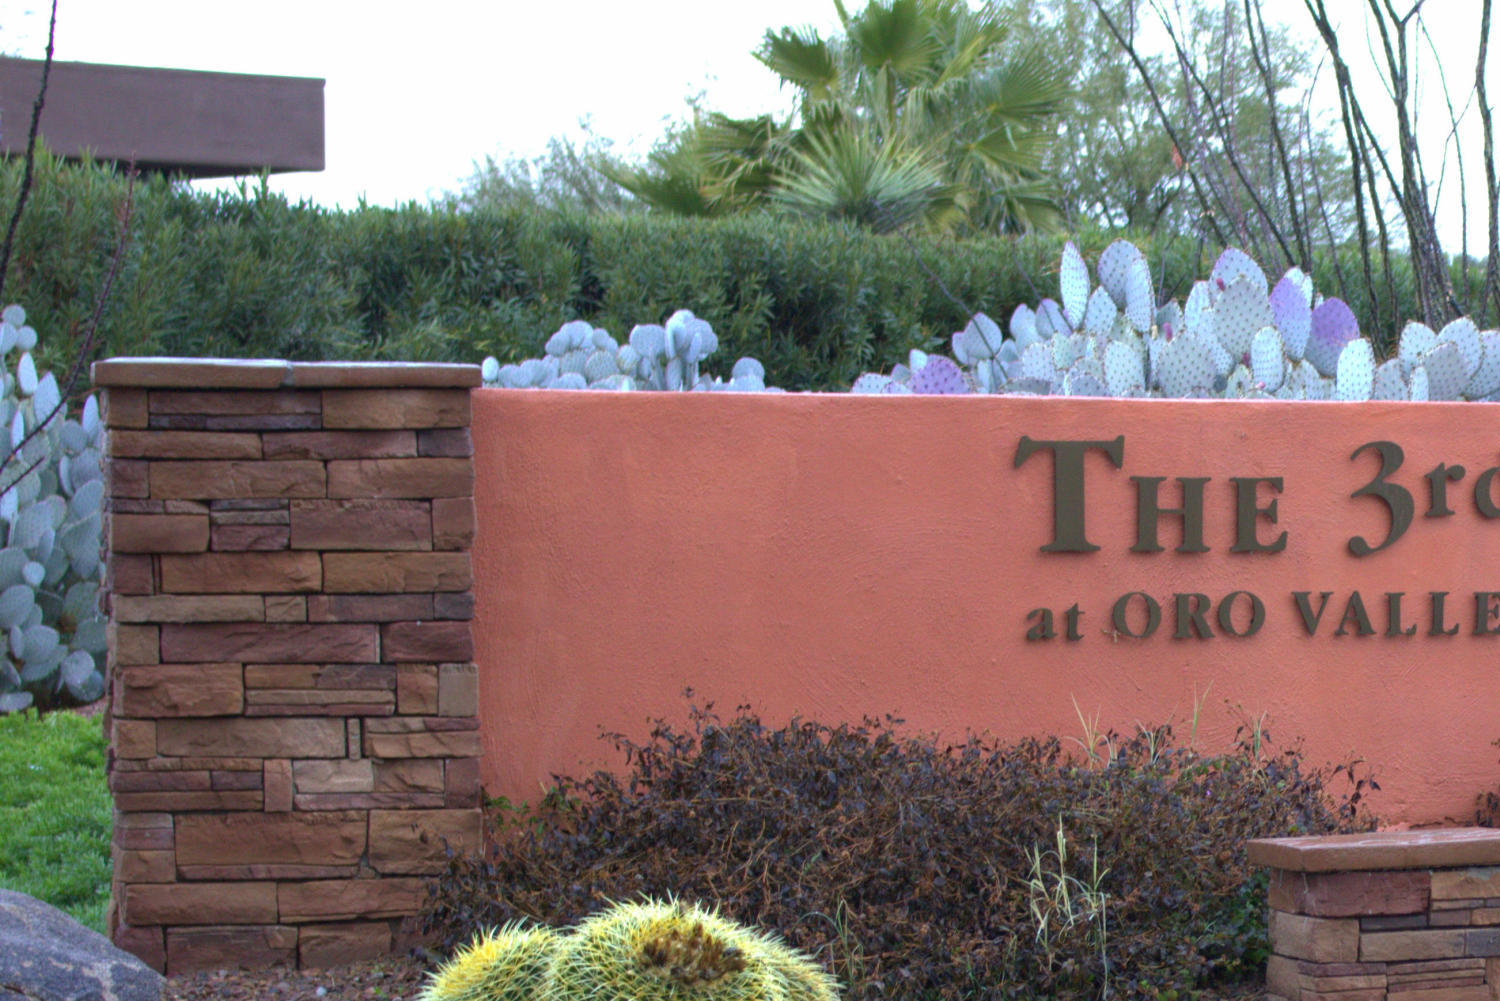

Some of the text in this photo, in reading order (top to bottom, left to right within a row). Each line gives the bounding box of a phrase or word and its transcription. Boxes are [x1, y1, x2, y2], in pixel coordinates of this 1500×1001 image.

[1012, 435, 1289, 559] THE
[1024, 592, 1085, 646] at
[1112, 590, 1267, 645] ORO
